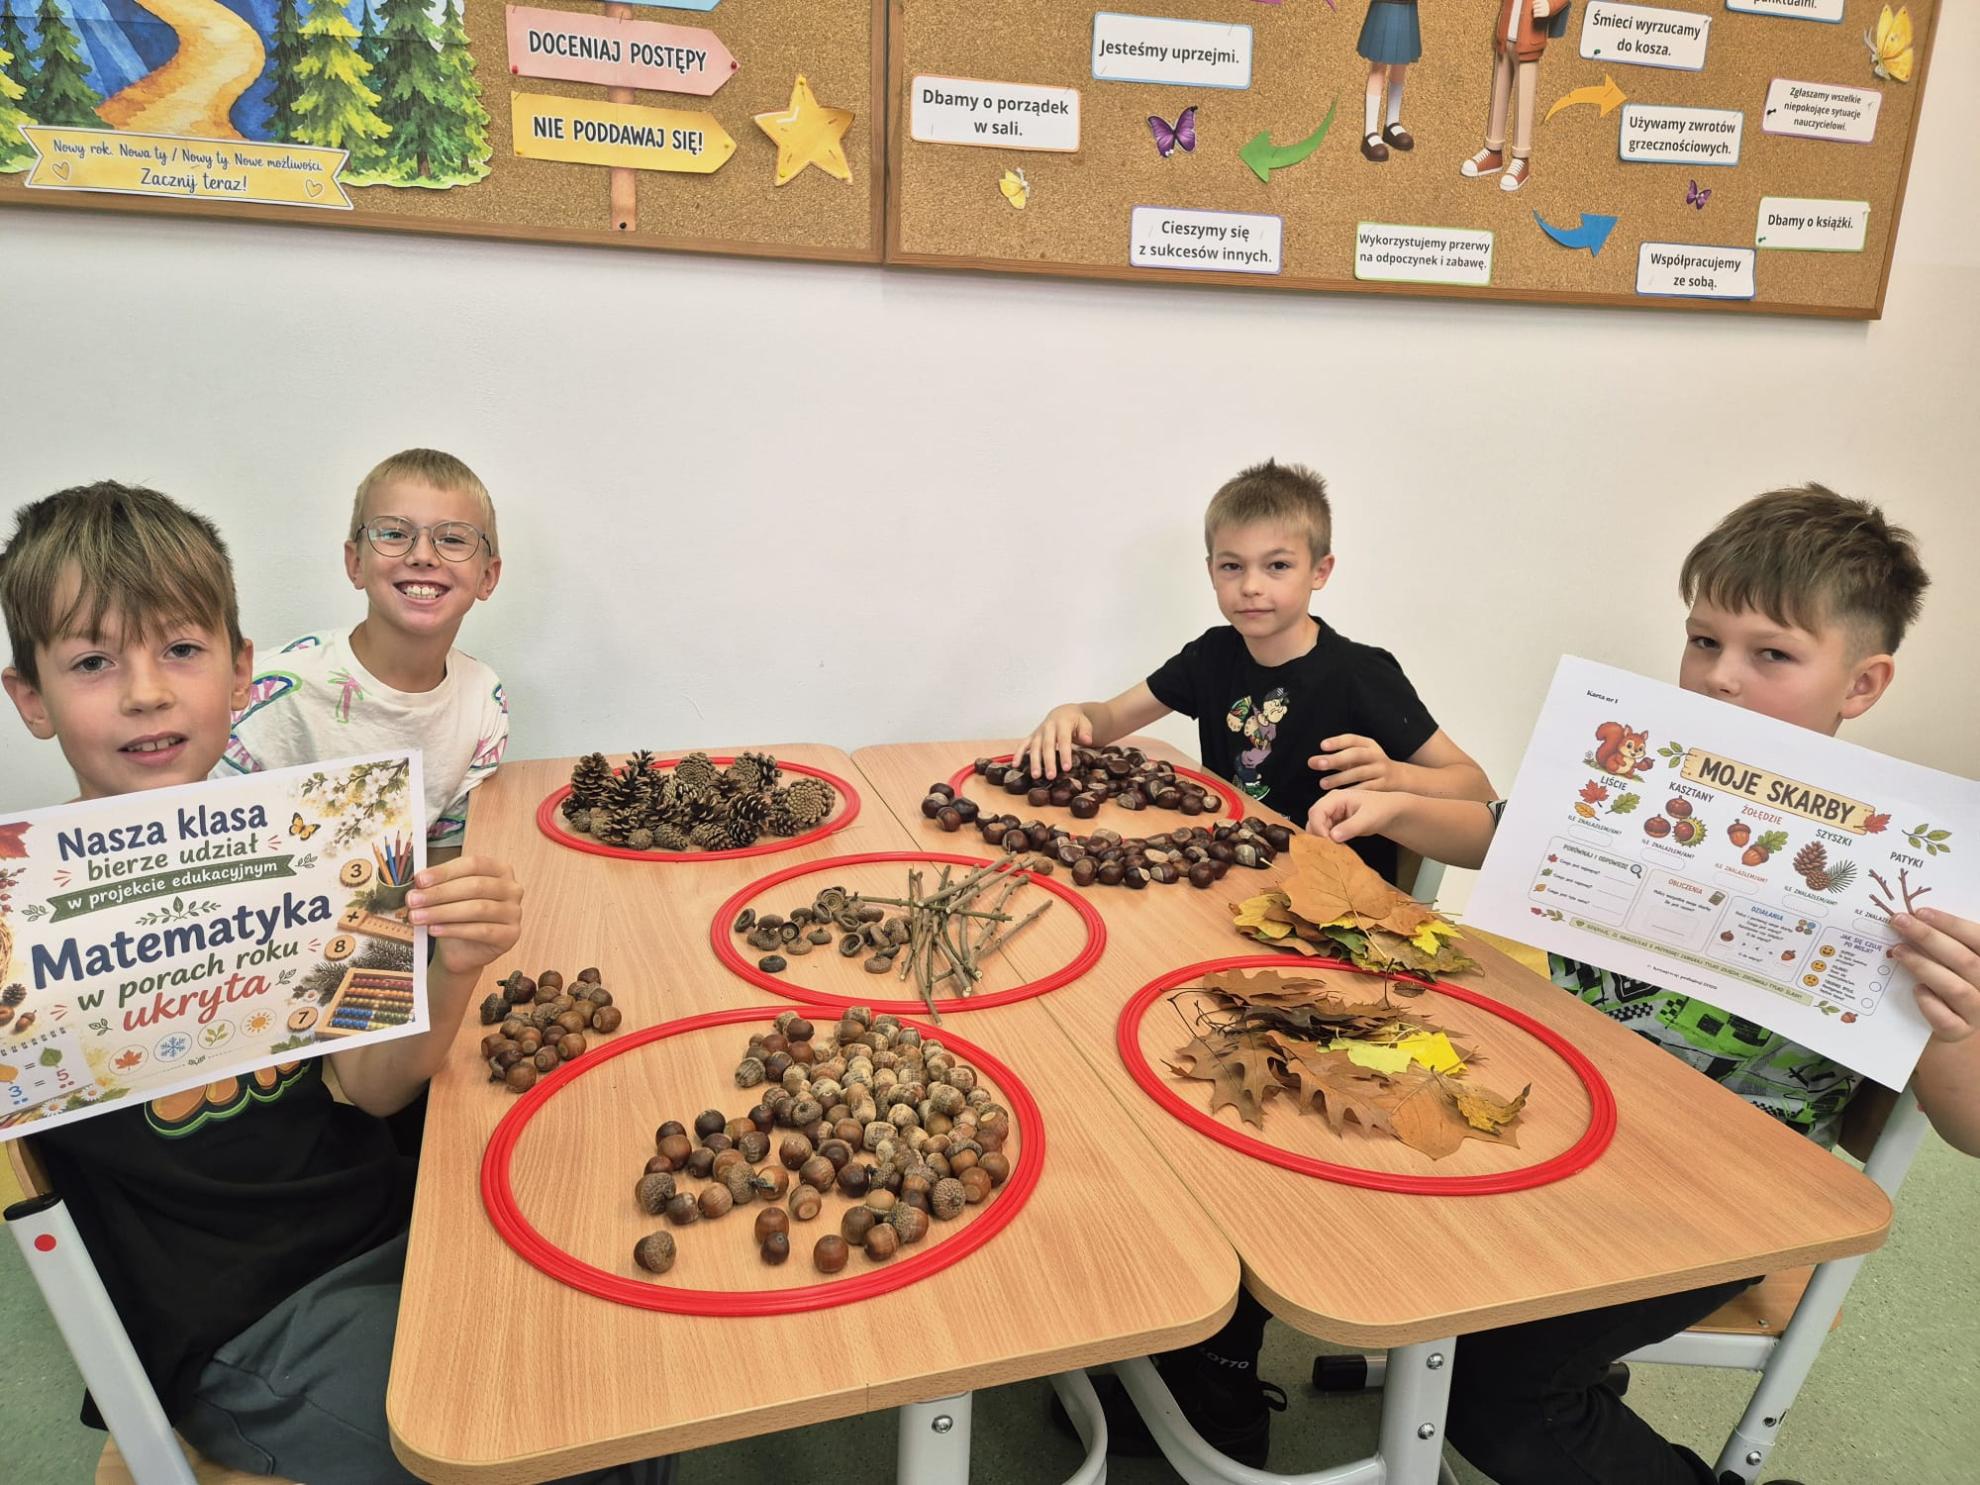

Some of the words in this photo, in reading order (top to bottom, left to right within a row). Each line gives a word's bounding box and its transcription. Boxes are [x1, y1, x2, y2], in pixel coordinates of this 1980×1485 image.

[1593, 10, 1633, 29] Śmieci
[1636, 19, 1701, 39] wyrzucamy
[529, 30, 621, 62] DOCENIAJ
[630, 43, 707, 73] POSTĘPY
[1099, 38, 1168, 61] Jesteśmy
[1172, 46, 1240, 65] uprzejmi.
[1617, 39, 1632, 52] do
[1635, 40, 1671, 56] kosza.
[922, 90, 979, 111] Dbamy
[983, 98, 992, 109] o
[997, 95, 1069, 117] porządek
[1790, 87, 1830, 102] Zgłaszamy
[1831, 94, 1862, 104] wszelkie
[1784, 102, 1830, 114] niepokojące
[1831, 108, 1861, 120] sytuacje
[533, 116, 564, 139] NIE
[573, 119, 665, 148] PODDAWAJ
[672, 131, 703, 154] SIĘ!
[974, 121, 989, 133] w
[992, 119, 1023, 136] sali.
[1629, 116, 1686, 134] Używamy
[1688, 118, 1736, 134] zwrotów
[53, 138, 86, 159] Nowy
[119, 143, 152, 158] Nowa
[182, 149, 213, 169] Nowy
[234, 152, 264, 167] Nowe
[1628, 137, 1731, 156] grzecznościowych.
[140, 167, 198, 193] Zacznij
[203, 172, 248, 191] teraz!
[1161, 220, 1227, 240] Cieszymy
[1230, 223, 1250, 240] się
[1767, 214, 1804, 230] Dbamy
[1807, 219, 1813, 227] o
[1816, 215, 1853, 231] książki.
[1139, 245, 1146, 256] z
[1150, 241, 1219, 260] sukcesów
[1222, 246, 1273, 265] innych.
[1359, 233, 1447, 251] Wykorzystujemy
[1449, 241, 1490, 254] przerwy
[1360, 253, 1373, 262] na
[1376, 252, 1438, 267] odpoczynek
[1440, 256, 1444, 266] i
[1446, 256, 1487, 271] zabawę.
[1650, 253, 1742, 272] Współpracujemy
[1673, 277, 1686, 286] ze
[1688, 275, 1717, 290] sobą.
[1600, 775, 1628, 791] LIŚCIE
[1668, 781, 1715, 803] KASZTANY
[1698, 757, 1762, 796] MOJE
[1766, 780, 1856, 824] SKARBY
[1741, 805, 1783, 826] ŻOŁĘDZIE
[57, 820, 168, 861] Nasza
[177, 804, 268, 841] klasa
[1815, 829, 1853, 847] SZYSZKI
[87, 852, 168, 882] bierze
[179, 834, 259, 864] udział
[1890, 851, 1924, 869] PATYKI
[350, 863, 362, 878] 3
[67, 898, 82, 910] w
[89, 877, 166, 908] projekcie
[172, 861, 278, 888] edukacyjnym
[32, 892, 332, 990] Matematyka
[334, 940, 346, 953] 8
[77, 988, 105, 1011] w
[118, 955, 224, 1009] porach
[236, 937, 299, 970] roku
[122, 971, 271, 1032] ukryta
[299, 1011, 309, 1024] 7
[8, 1085, 23, 1098] 3
[56, 1068, 70, 1081] 5
[1201, 1346, 1249, 1369] OTTO
